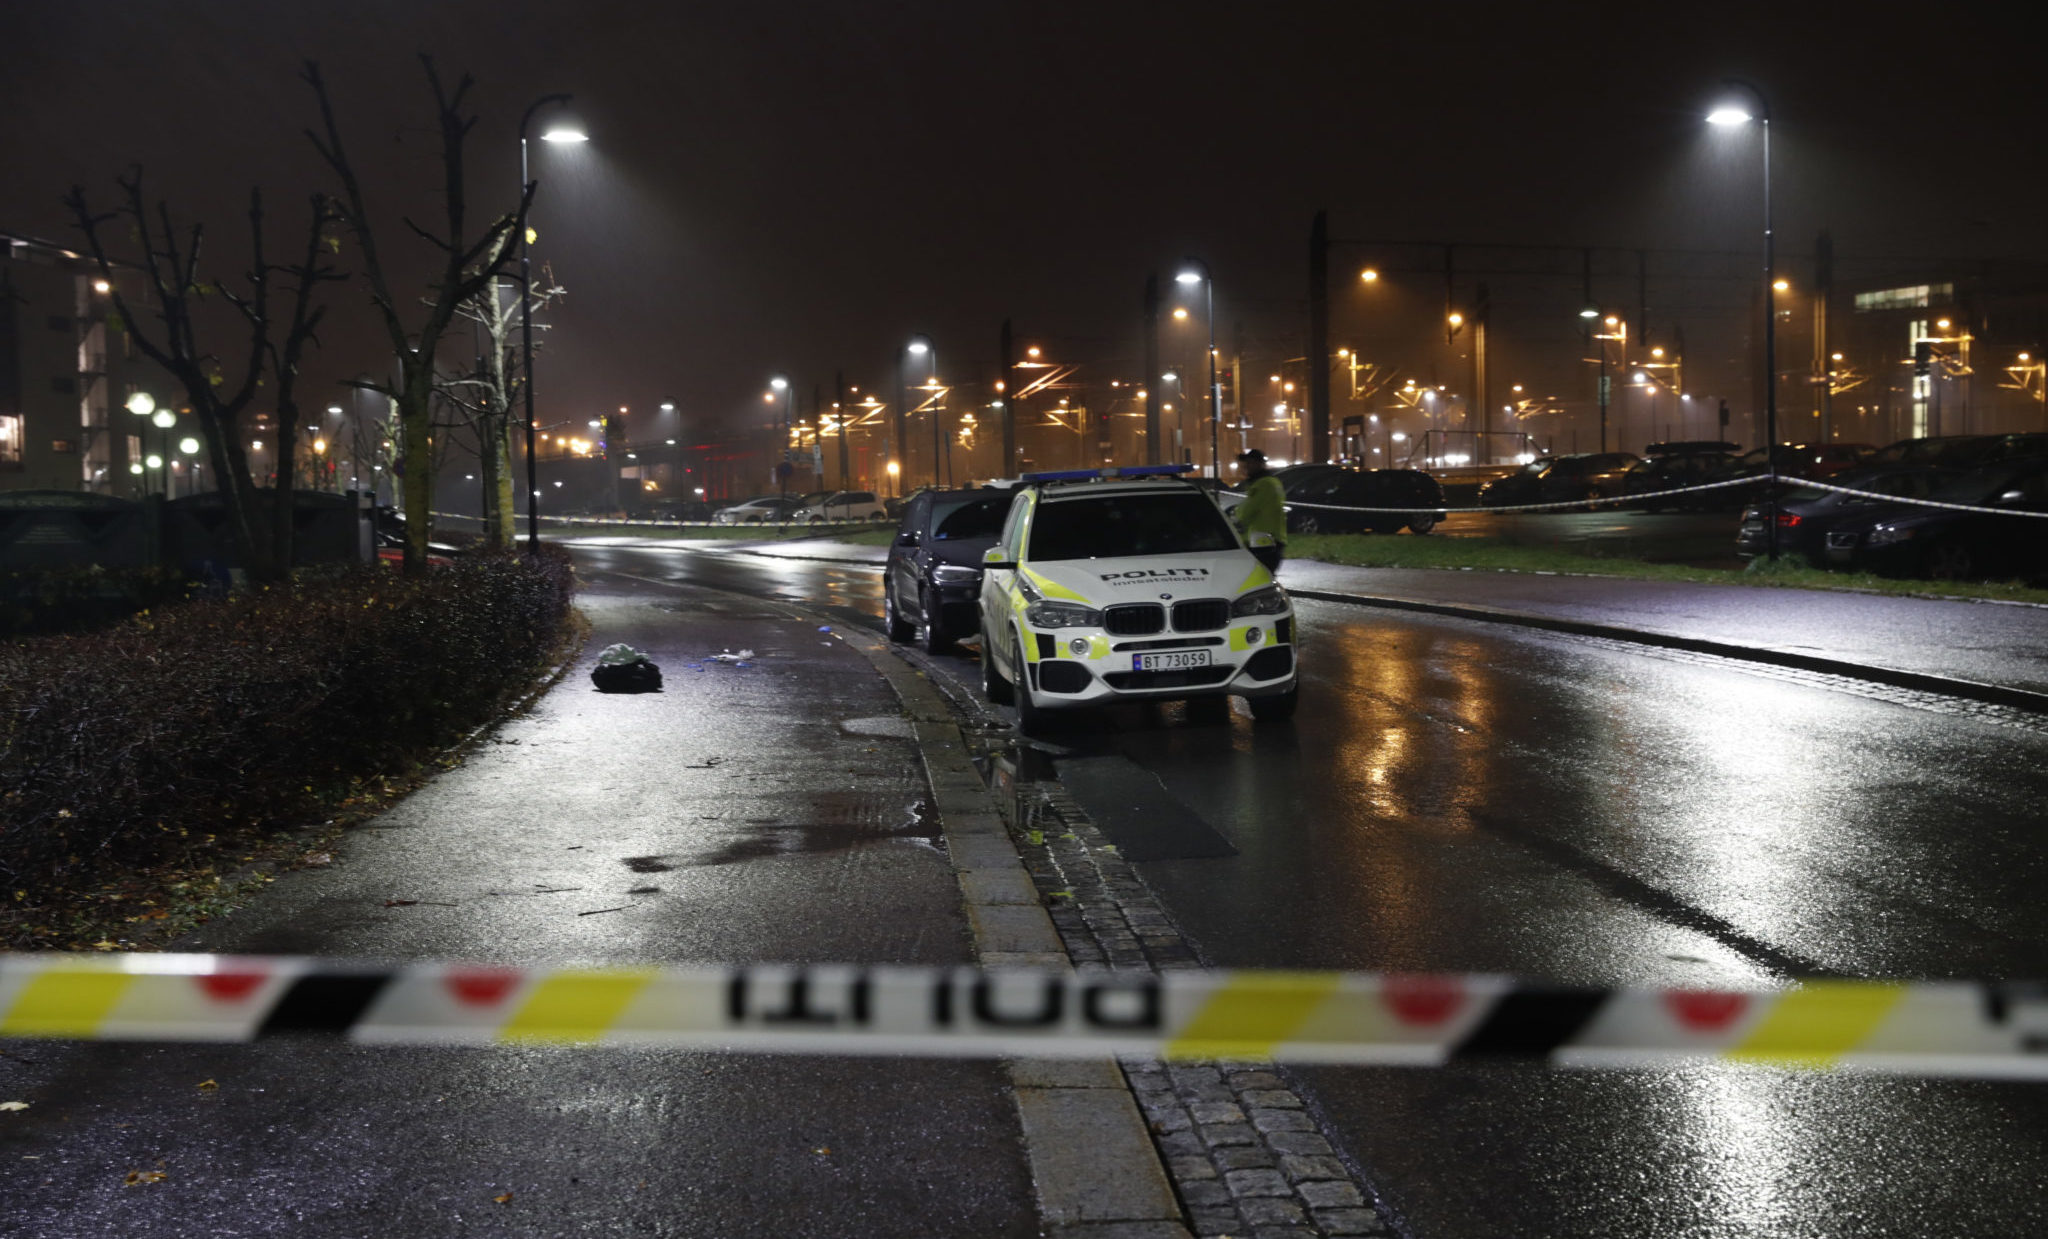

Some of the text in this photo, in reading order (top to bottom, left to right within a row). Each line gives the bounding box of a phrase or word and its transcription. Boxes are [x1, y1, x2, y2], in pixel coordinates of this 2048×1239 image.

[1100, 568, 1209, 581] POLITI
[1144, 653, 1205, 668] BT 73059
